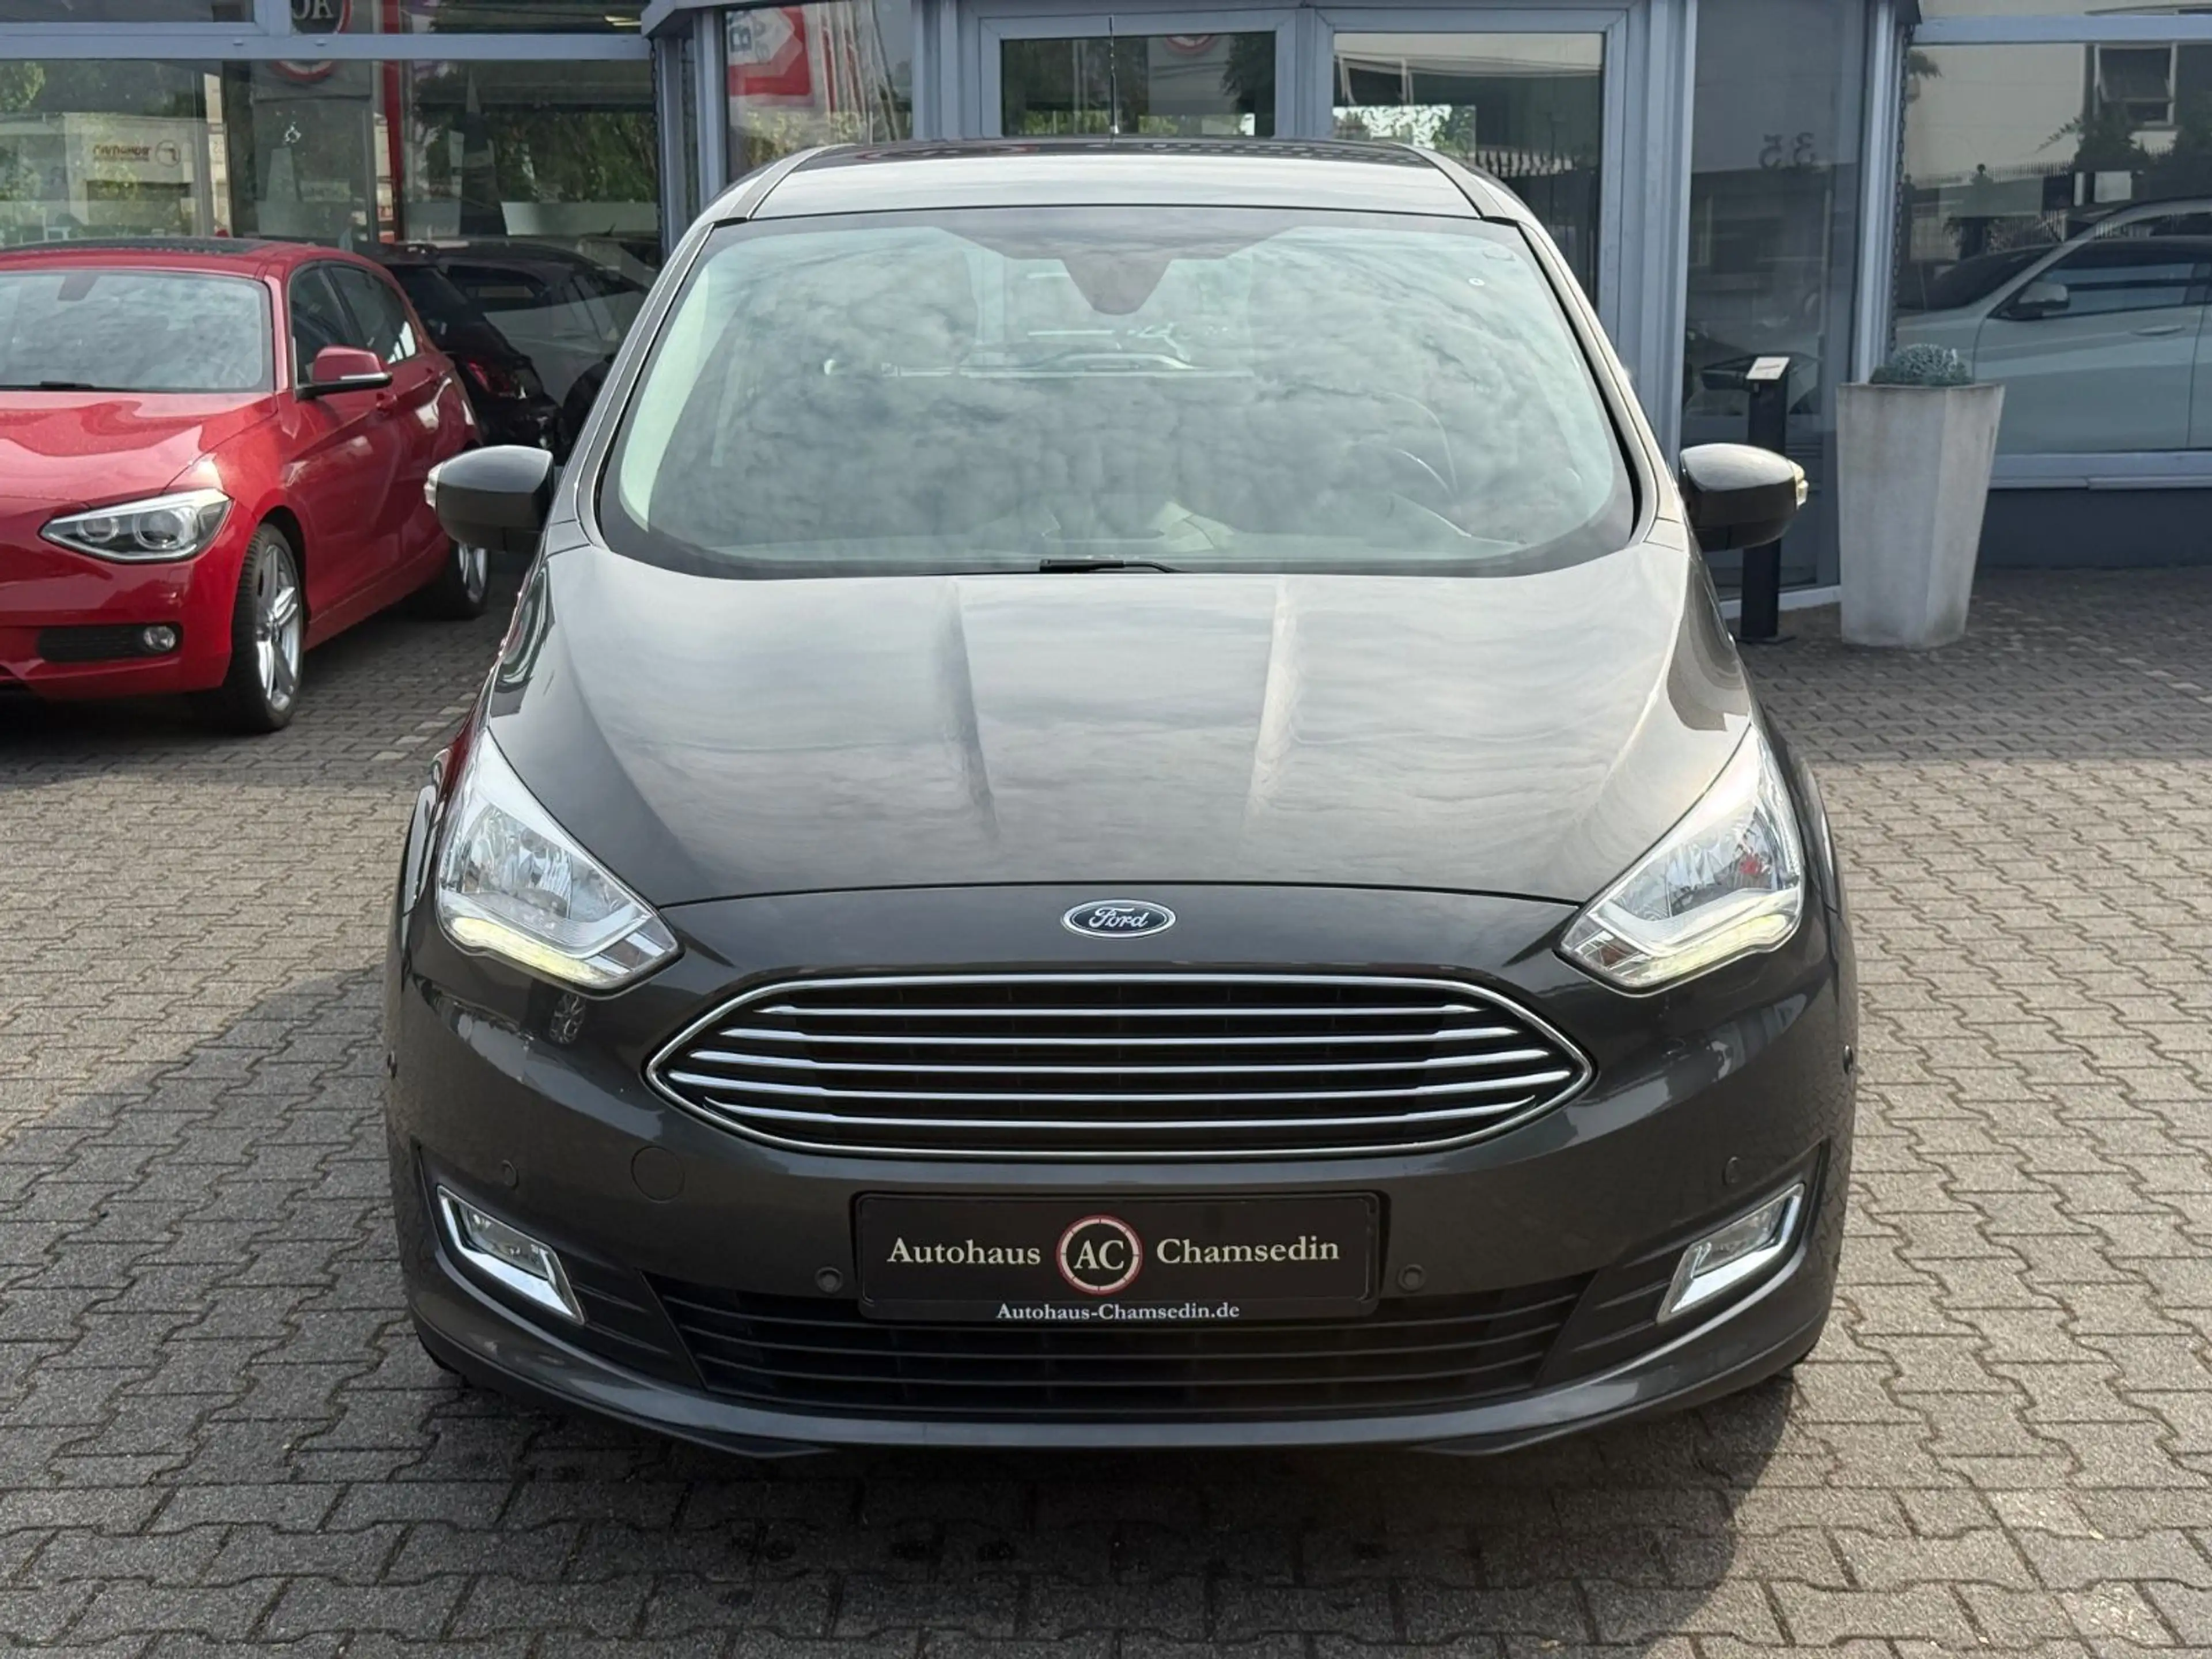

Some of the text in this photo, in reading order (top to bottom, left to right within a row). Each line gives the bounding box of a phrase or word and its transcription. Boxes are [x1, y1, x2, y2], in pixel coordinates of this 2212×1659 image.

[1088, 907, 1149, 928] Ford
[887, 1236, 1339, 1271] Autohaus AC Chamsedin
[997, 1302, 1240, 1320] Autohaus-Chamsedin.de
